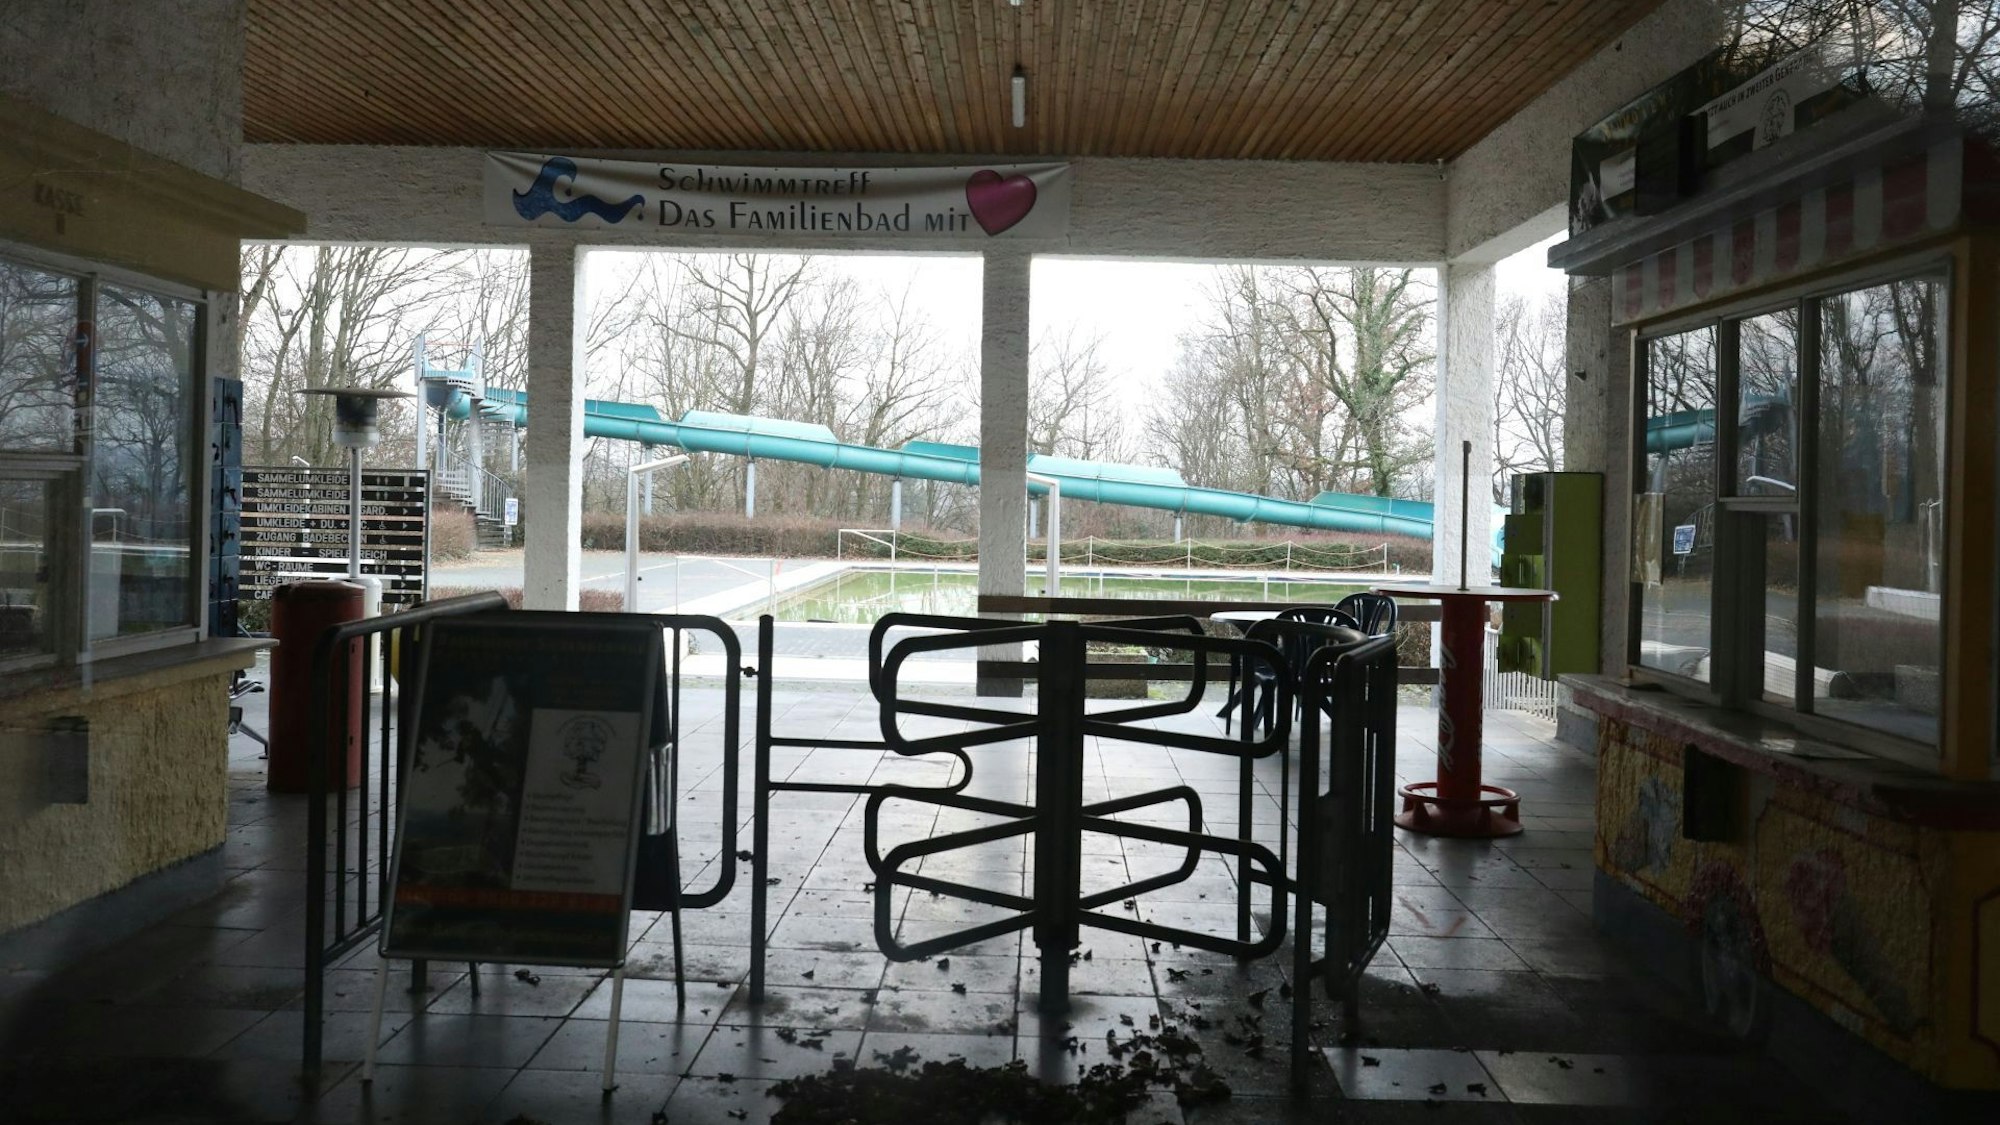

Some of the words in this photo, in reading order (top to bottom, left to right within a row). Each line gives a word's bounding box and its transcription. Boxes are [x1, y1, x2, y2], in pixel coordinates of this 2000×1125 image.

[257, 473, 348, 485] SAMMELUMKLEIDE
[257, 488, 347, 500] SAMMELUMKLEIDE
[256, 503, 346, 515] UMKLEIDEKABINEN
[256, 518, 306, 528] UMKLEIDE
[320, 519, 338, 529] DU.
[255, 531, 297, 542] ZUGANG
[302, 532, 368, 544] BADEBECN
[255, 547, 292, 557] KINDER
[318, 548, 389, 560] SPIELBREICH
